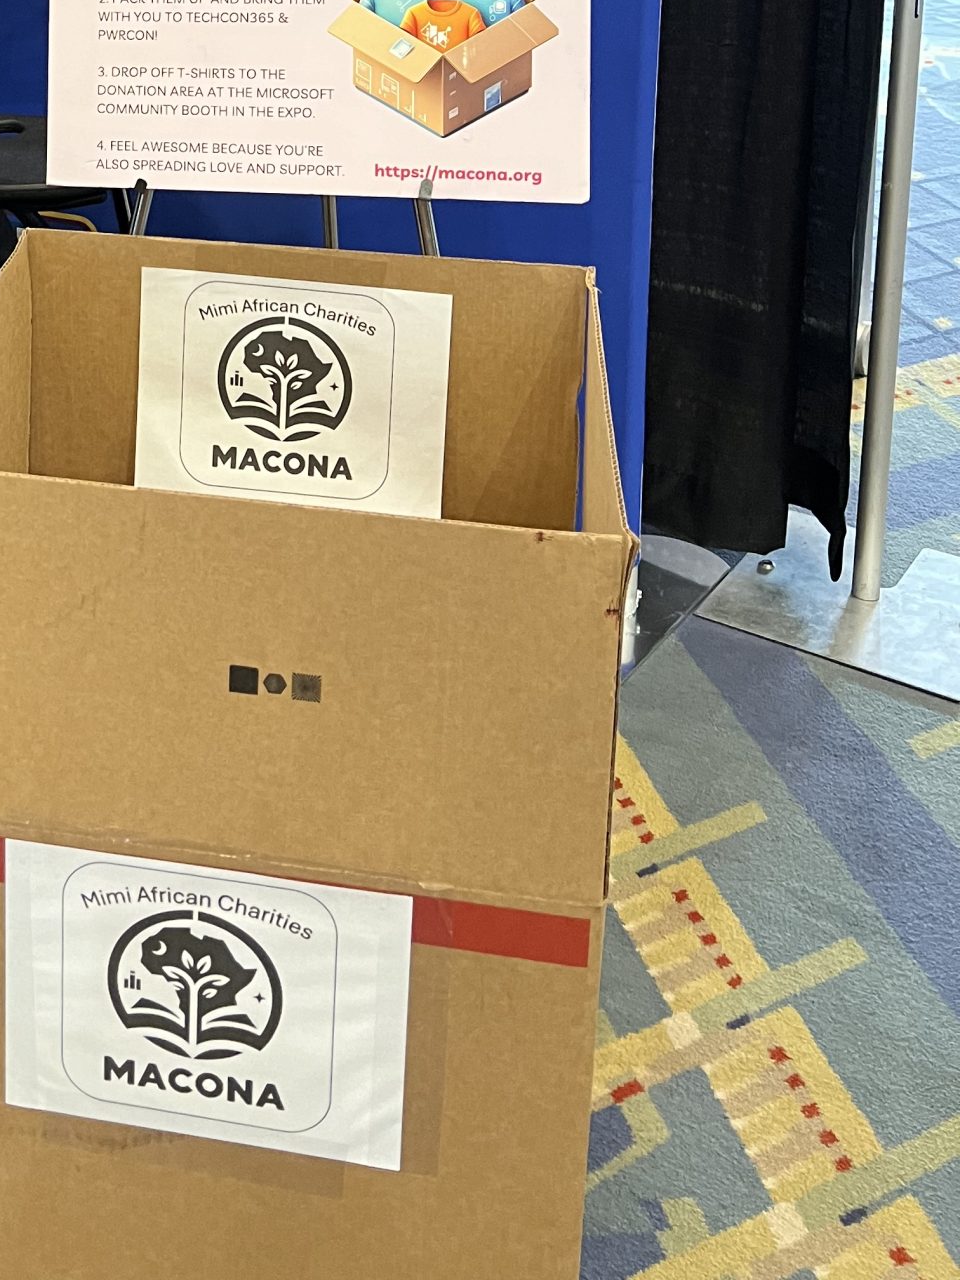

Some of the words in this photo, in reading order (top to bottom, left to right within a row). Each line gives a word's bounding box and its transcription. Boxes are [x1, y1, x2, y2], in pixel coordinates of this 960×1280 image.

[98, 12, 130, 22] WITH
[134, 12, 161, 22] YOU
[166, 12, 182, 22] TO
[186, 12, 274, 23] TECHCON365
[278, 13, 289, 23] &
[98, 30, 158, 41] PWRCON!
[98, 67, 108, 77] 3.
[111, 67, 147, 78] DROP
[151, 67, 175, 78] OFF
[177, 68, 235, 79] T-SHIRTS
[239, 69, 257, 79] TO
[260, 69, 286, 80] THE
[97, 85, 167, 96] DONATION
[170, 86, 204, 97] AREA
[207, 87, 224, 97] AT
[228, 87, 252, 98] THE
[256, 88, 335, 100] MICROSOFT
[97, 103, 178, 115] COMMUNITY
[182, 105, 227, 116] BOOTH
[232, 106, 245, 116] IN
[249, 106, 273, 117] THE
[278, 107, 315, 118] EXPO.
[96, 141, 107, 151] 4.
[111, 141, 138, 151] FEEL
[141, 142, 209, 153] AWESOME
[212, 143, 272, 155] BECAUSE
[276, 144, 323, 156] YOU'RE
[96, 159, 129, 170] ALSO
[133, 160, 206, 172] SPREADING
[210, 162, 243, 173] LOVE
[247, 163, 276, 174] AND
[280, 164, 345, 177] SUPPORT.
[374, 163, 542, 185] https://macona.org
[199, 300, 238, 321] Mimi
[242, 299, 299, 314] African
[304, 302, 377, 337] Charities
[212, 445, 352, 481] MACONA
[80, 886, 131, 909] Mimi
[137, 886, 211, 908] African
[218, 894, 314, 940] Charities
[103, 1055, 285, 1111] MACONA
